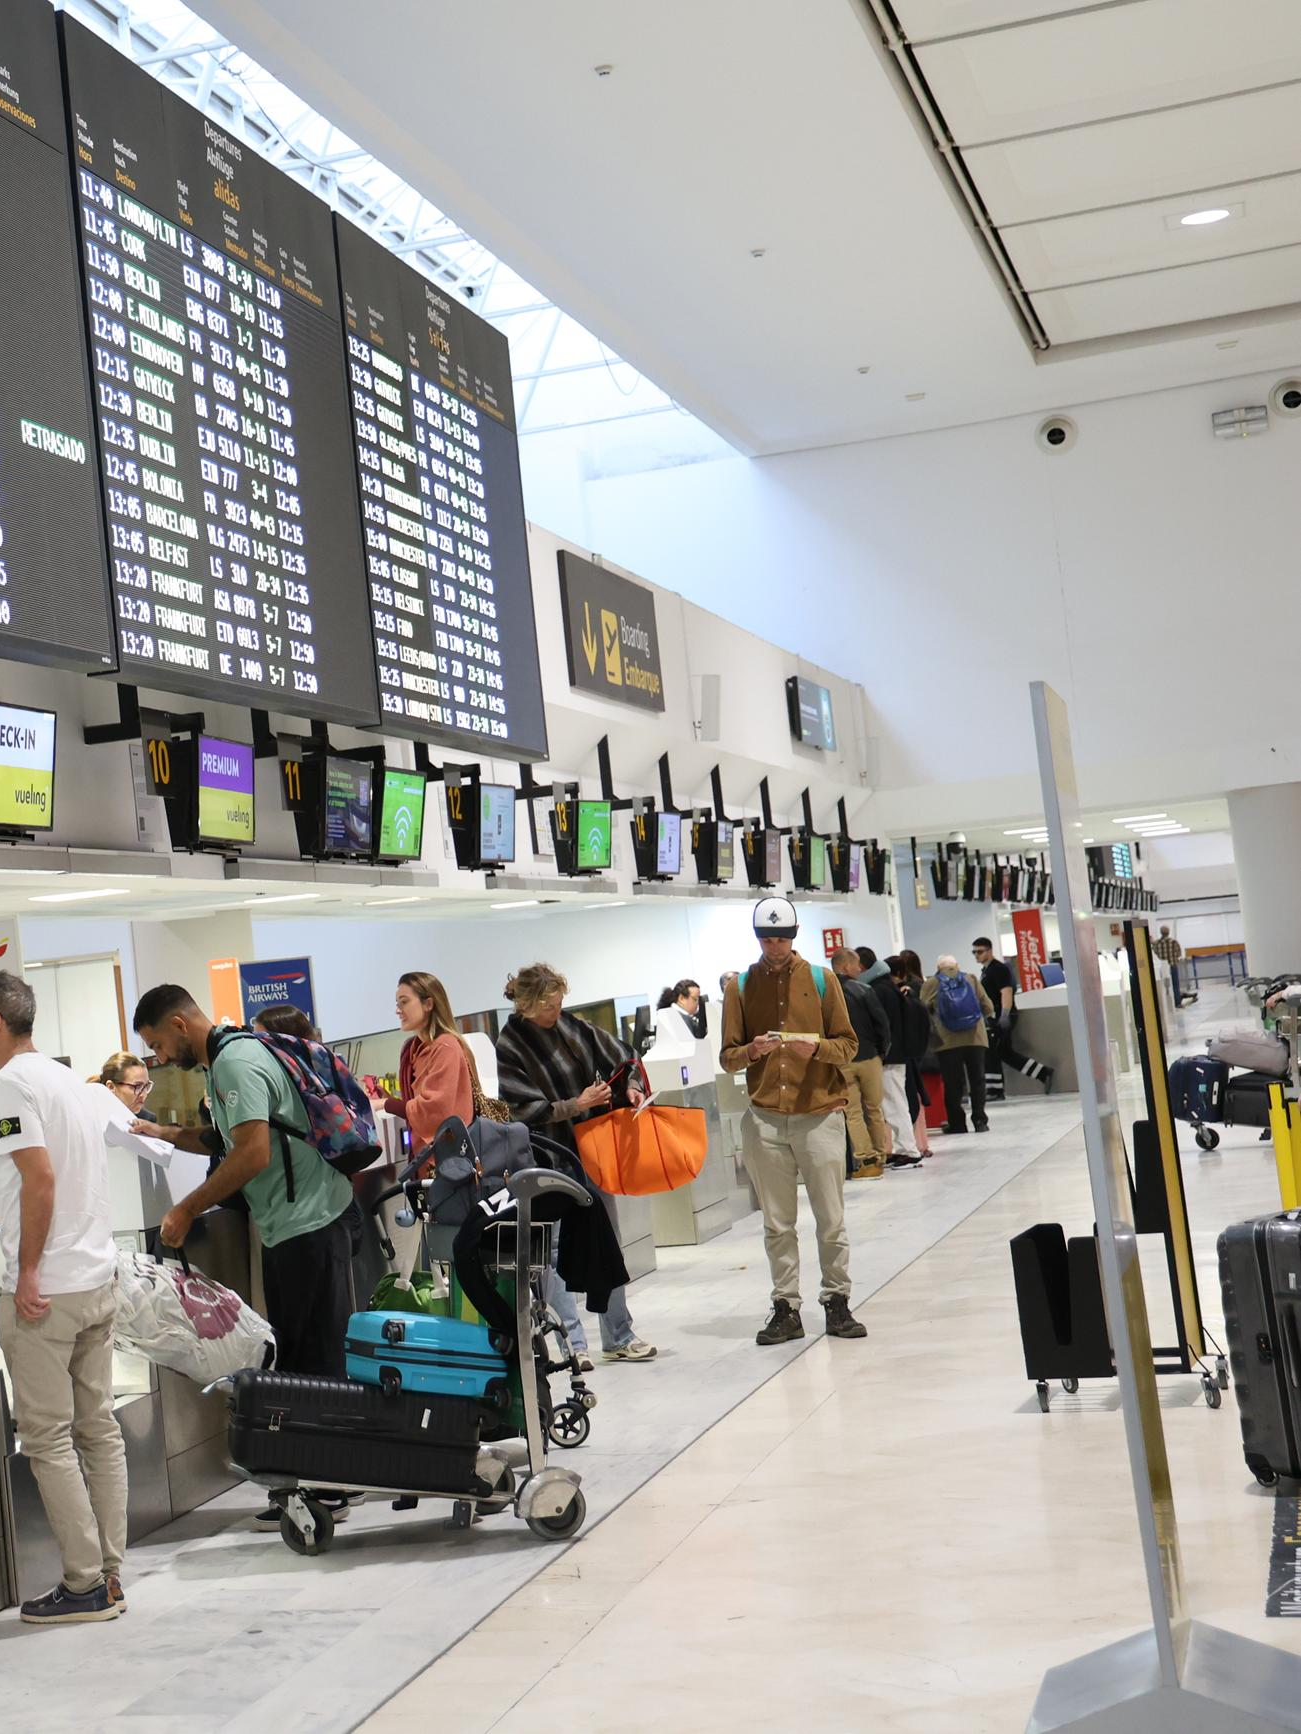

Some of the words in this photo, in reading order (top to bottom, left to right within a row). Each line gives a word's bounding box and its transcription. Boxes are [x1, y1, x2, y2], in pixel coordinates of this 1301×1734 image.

[78, 145, 93, 166] Hora
[204, 120, 242, 162] Departures
[115, 168, 136, 192] Destino
[206, 146, 234, 181] Abflüge
[79, 171, 113, 210] 11:40
[179, 232, 193, 258] LS
[178, 208, 194, 226] Vuelo
[20, 417, 86, 465] RETRASADO
[110, 523, 145, 554] 13:05
[147, 535, 188, 568] BELFAST
[209, 555, 223, 578] LS
[229, 562, 248, 586] 310
[282, 579, 309, 605] 12:35
[620, 615, 650, 658] Boarding
[120, 629, 154, 658] 13:20
[218, 652, 233, 675] DE
[268, 664, 285, 686] 5-7
[292, 669, 318, 694] 12:50
[624, 656, 660, 699] Embarque
[442, 706, 453, 725] LS
[148, 739, 170, 785] 10
[202, 752, 240, 778] PREMIUM
[285, 760, 300, 800] 11
[14, 784, 46, 812] vueling
[448, 786, 462, 820] 12
[226, 804, 250, 830] vueling
[556, 802, 568, 832] 13
[248, 982, 287, 994] BRITISH
[248, 990, 288, 1002] AIRWAYS
